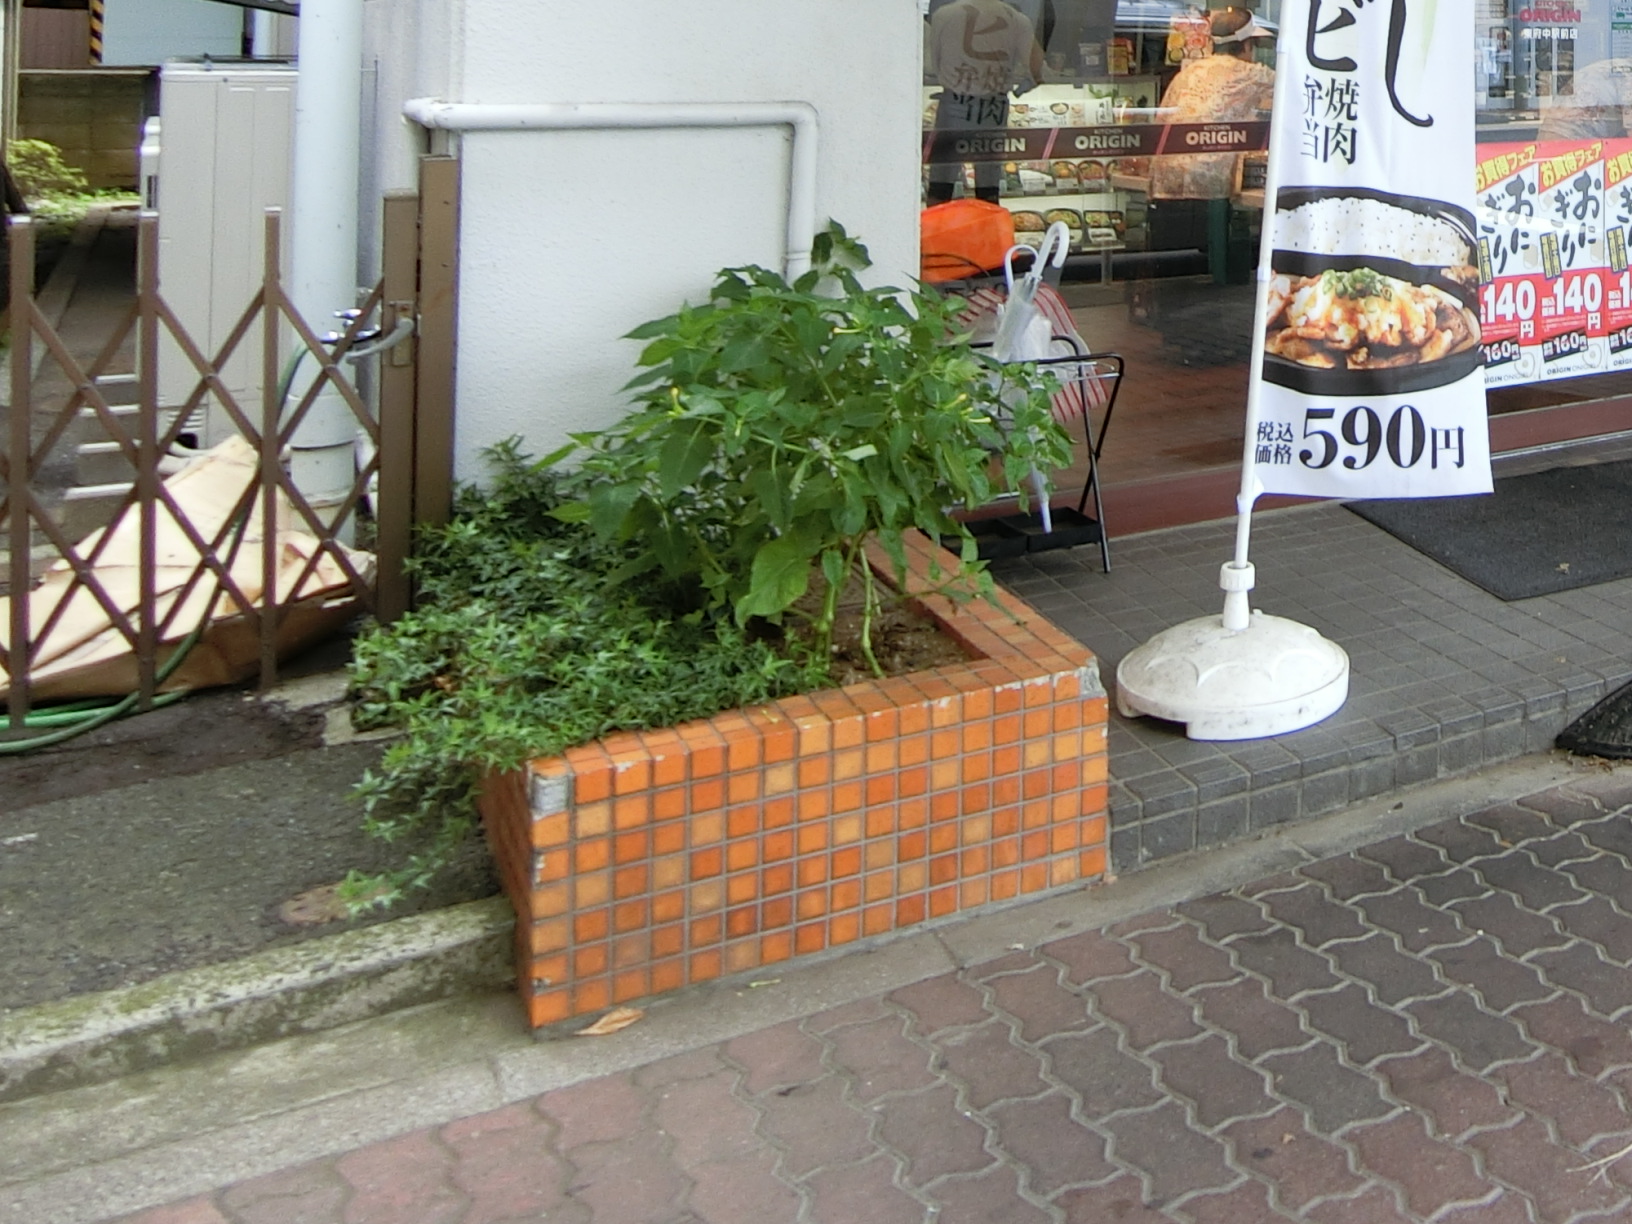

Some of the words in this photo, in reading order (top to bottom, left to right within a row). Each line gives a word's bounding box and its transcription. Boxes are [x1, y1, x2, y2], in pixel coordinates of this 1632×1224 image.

[1520, 7, 1582, 23] ORIGIN
[1300, 73, 1324, 161] 弁当
[1323, 77, 1361, 165] 焼肉
[955, 137, 1027, 155] ORIGIN
[1074, 134, 1141, 151] ORIGIN
[1185, 131, 1248, 147] ORIGIN
[1540, 140, 1603, 188] お買得フェア
[1546, 366, 1571, 376] ORIGIN
[1256, 421, 1294, 444] 税込
[1298, 404, 1465, 471] 590円
[1254, 443, 1293, 466] 価格
